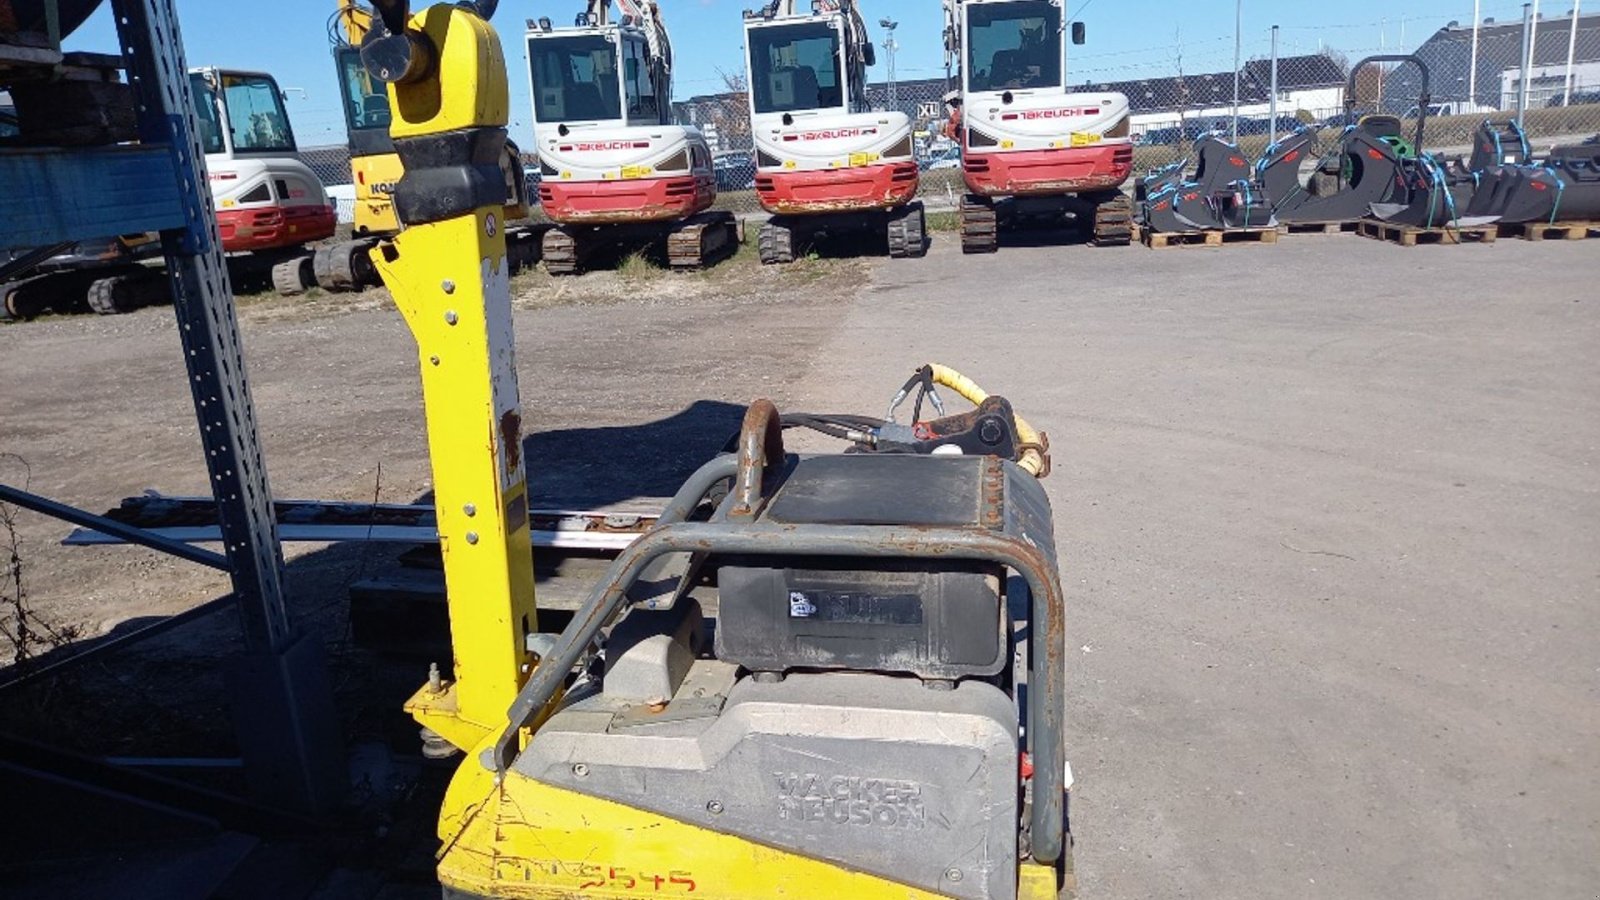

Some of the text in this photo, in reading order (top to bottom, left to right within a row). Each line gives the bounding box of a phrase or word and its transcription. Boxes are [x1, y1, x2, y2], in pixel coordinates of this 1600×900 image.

[920, 103, 938, 117] XL
[1020, 108, 1083, 120] TAKEUCHI
[801, 128, 860, 141] TAKEUCHI
[574, 142, 631, 151] TAKEUCHI
[773, 771, 923, 801] WACKER
[777, 798, 926, 829] NEUSON
